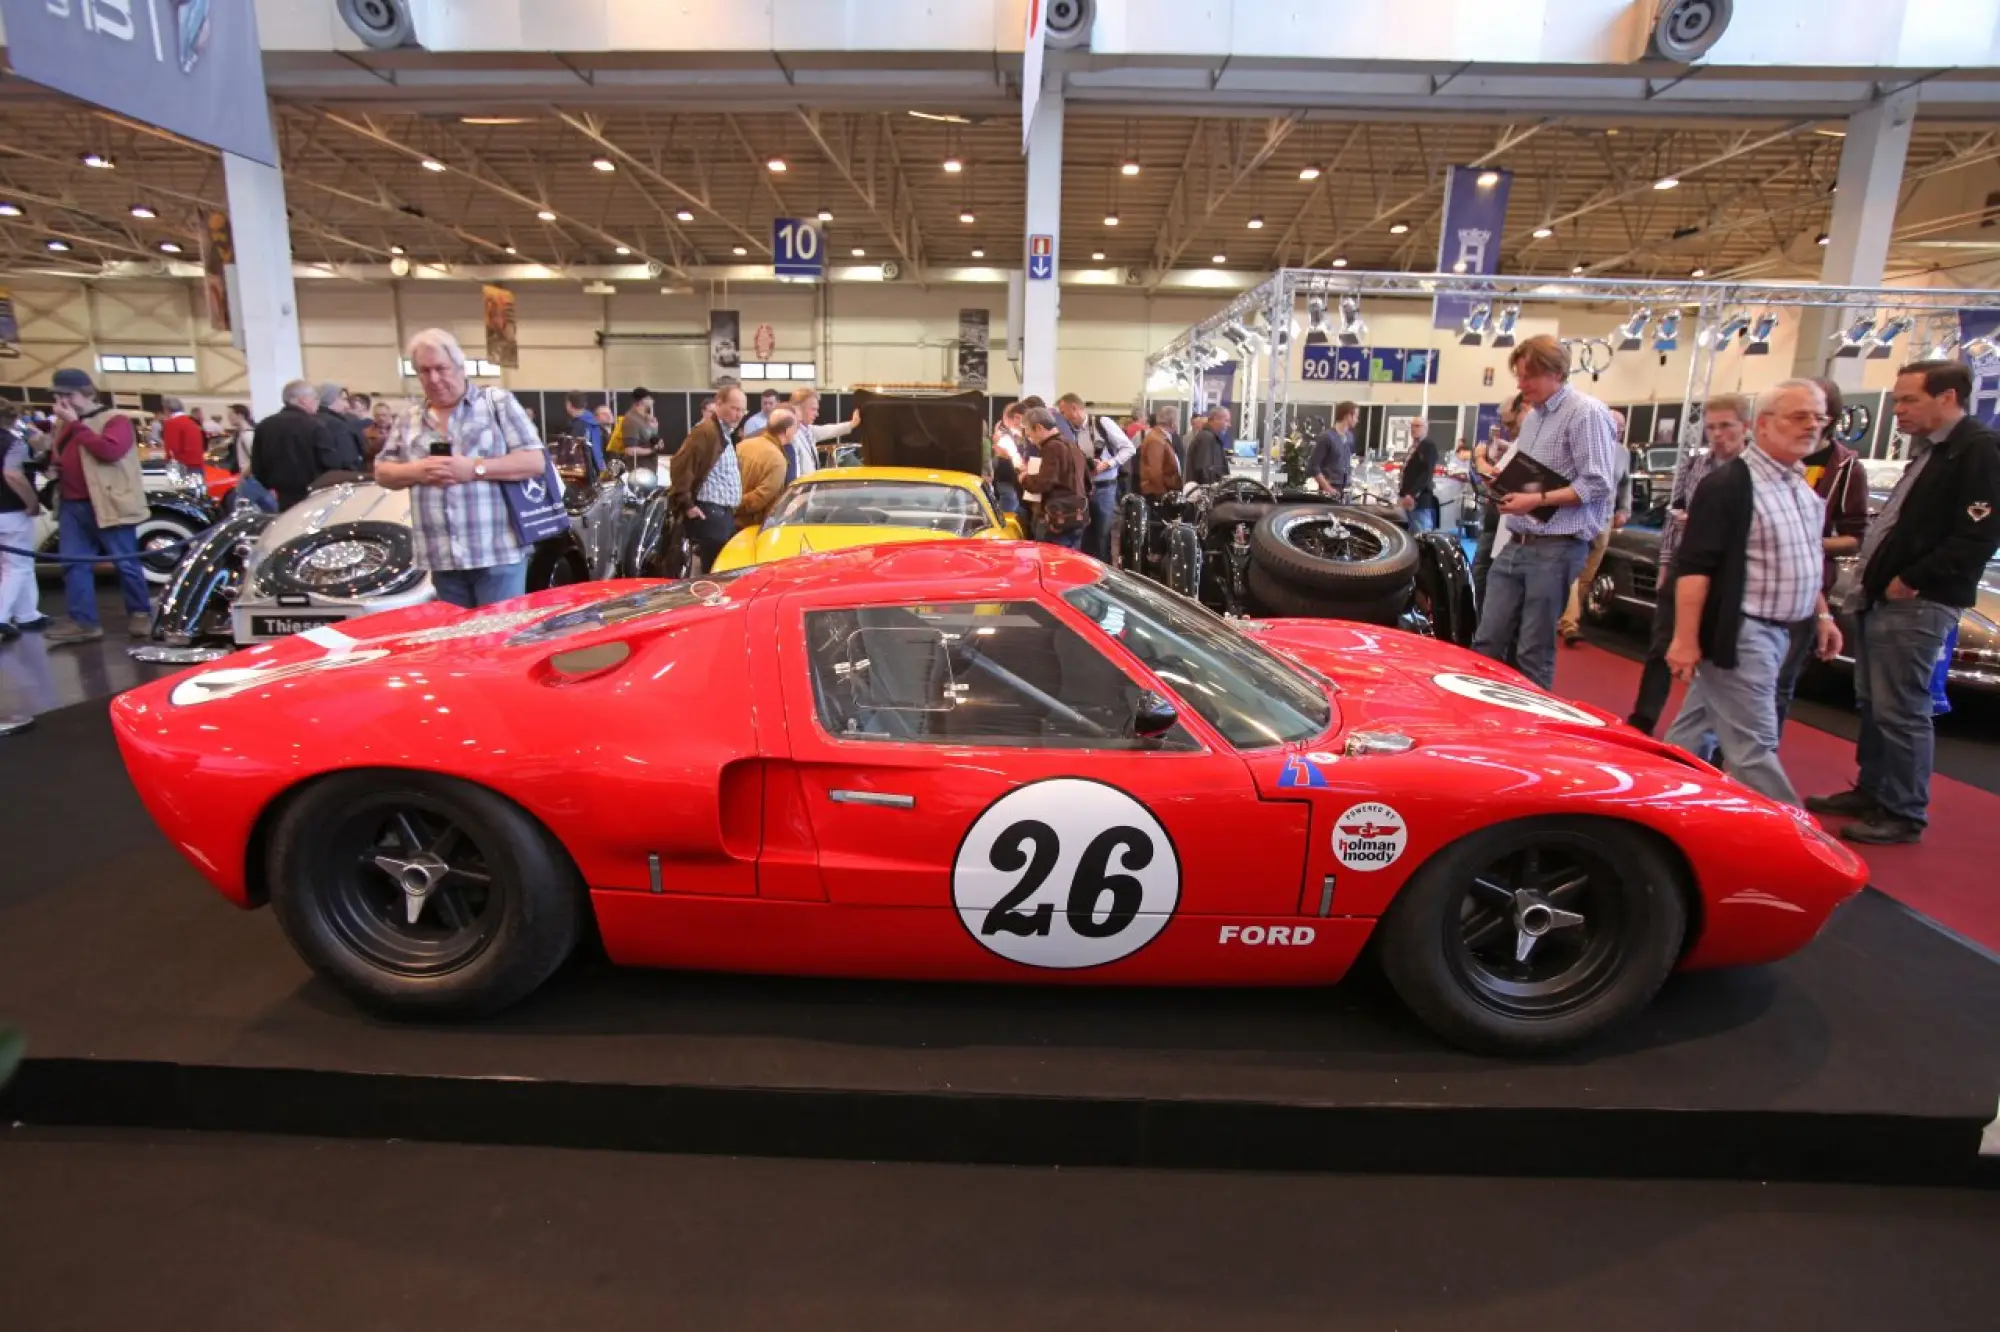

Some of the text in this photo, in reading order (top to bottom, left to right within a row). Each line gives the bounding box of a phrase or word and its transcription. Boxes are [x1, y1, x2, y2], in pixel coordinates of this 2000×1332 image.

[778, 224, 817, 260] 10
[1304, 359, 1360, 379] 9.0 9.1
[1346, 805, 1383, 820] POWERED
[1339, 838, 1396, 852] holman
[1343, 851, 1394, 863] moody
[981, 819, 1154, 938] 26
[1218, 925, 1316, 946] FORD
